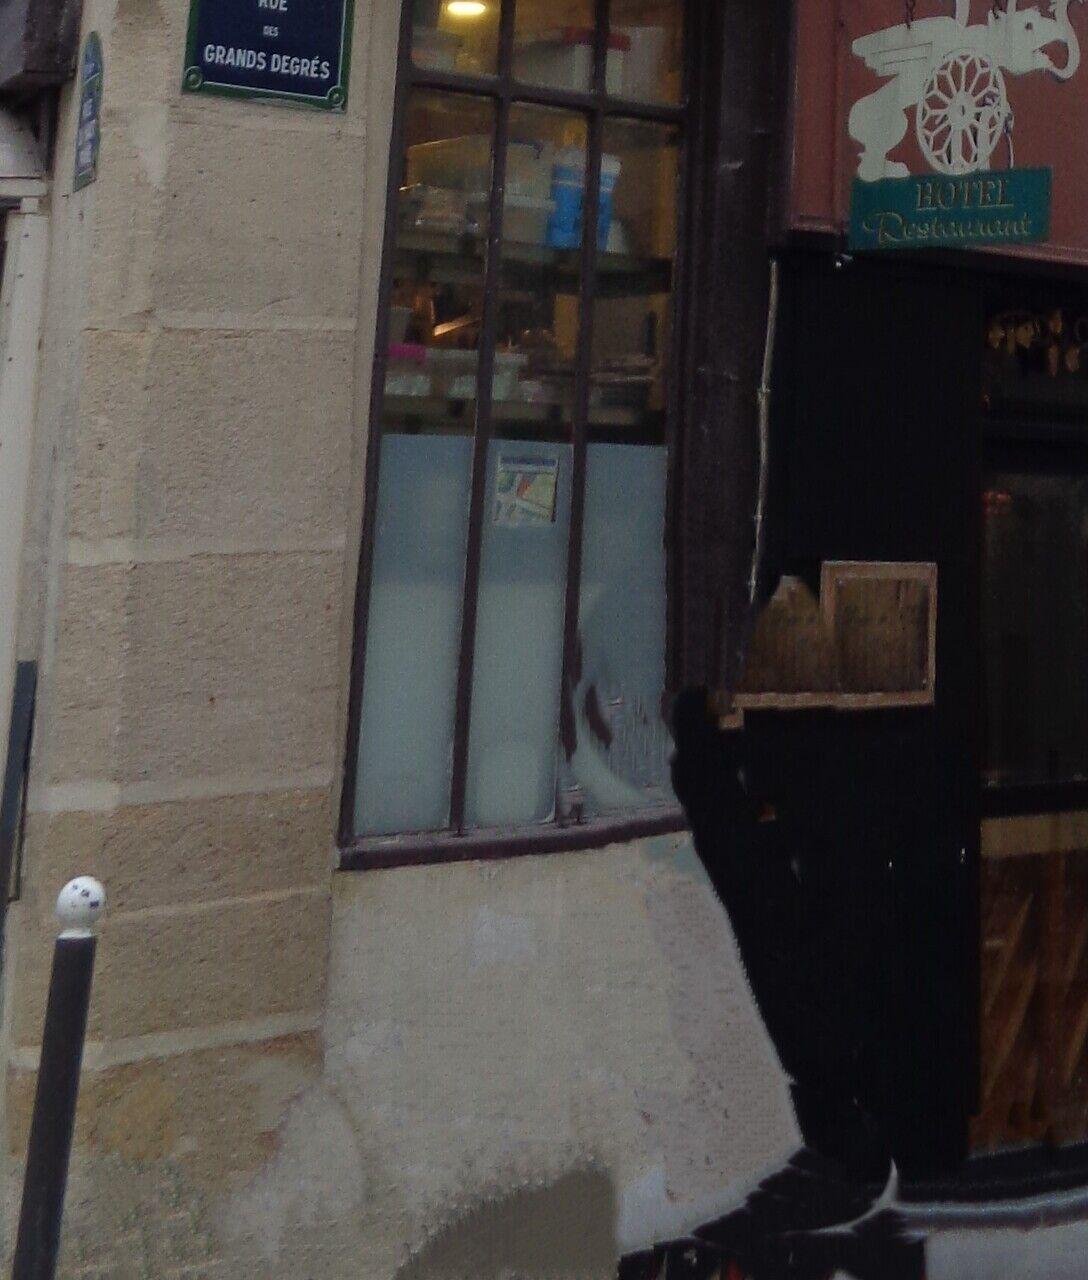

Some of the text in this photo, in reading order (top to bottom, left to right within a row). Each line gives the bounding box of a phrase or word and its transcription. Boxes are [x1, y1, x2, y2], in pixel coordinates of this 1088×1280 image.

[262, 25, 279, 37] DES
[204, 44, 331, 80] GRANDS DEGRÉS
[915, 178, 1015, 212] HOTEL
